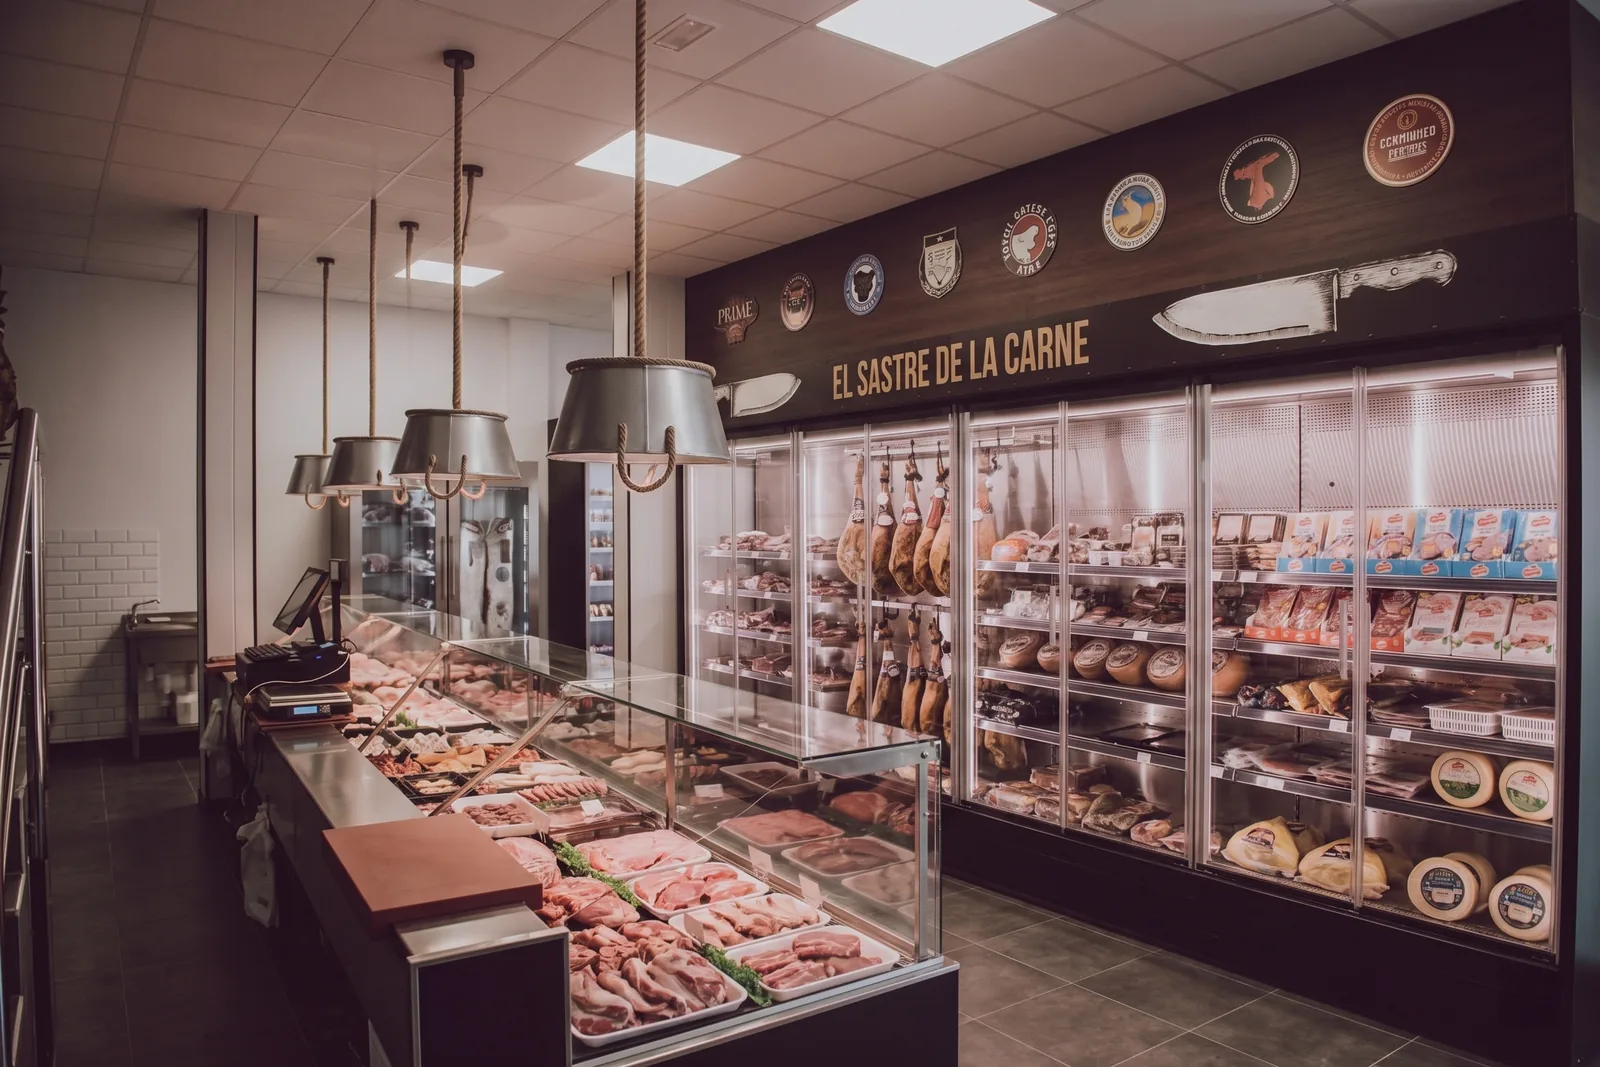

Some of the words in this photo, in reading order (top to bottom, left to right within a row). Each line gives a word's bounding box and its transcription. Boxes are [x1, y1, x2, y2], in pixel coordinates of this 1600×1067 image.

[717, 300, 753, 325] PRIME
[833, 364, 853, 400] EL
[857, 348, 930, 397] SASTRE
[936, 342, 963, 385] DE
[970, 336, 998, 380] LA
[1004, 319, 1090, 376] CARNE
